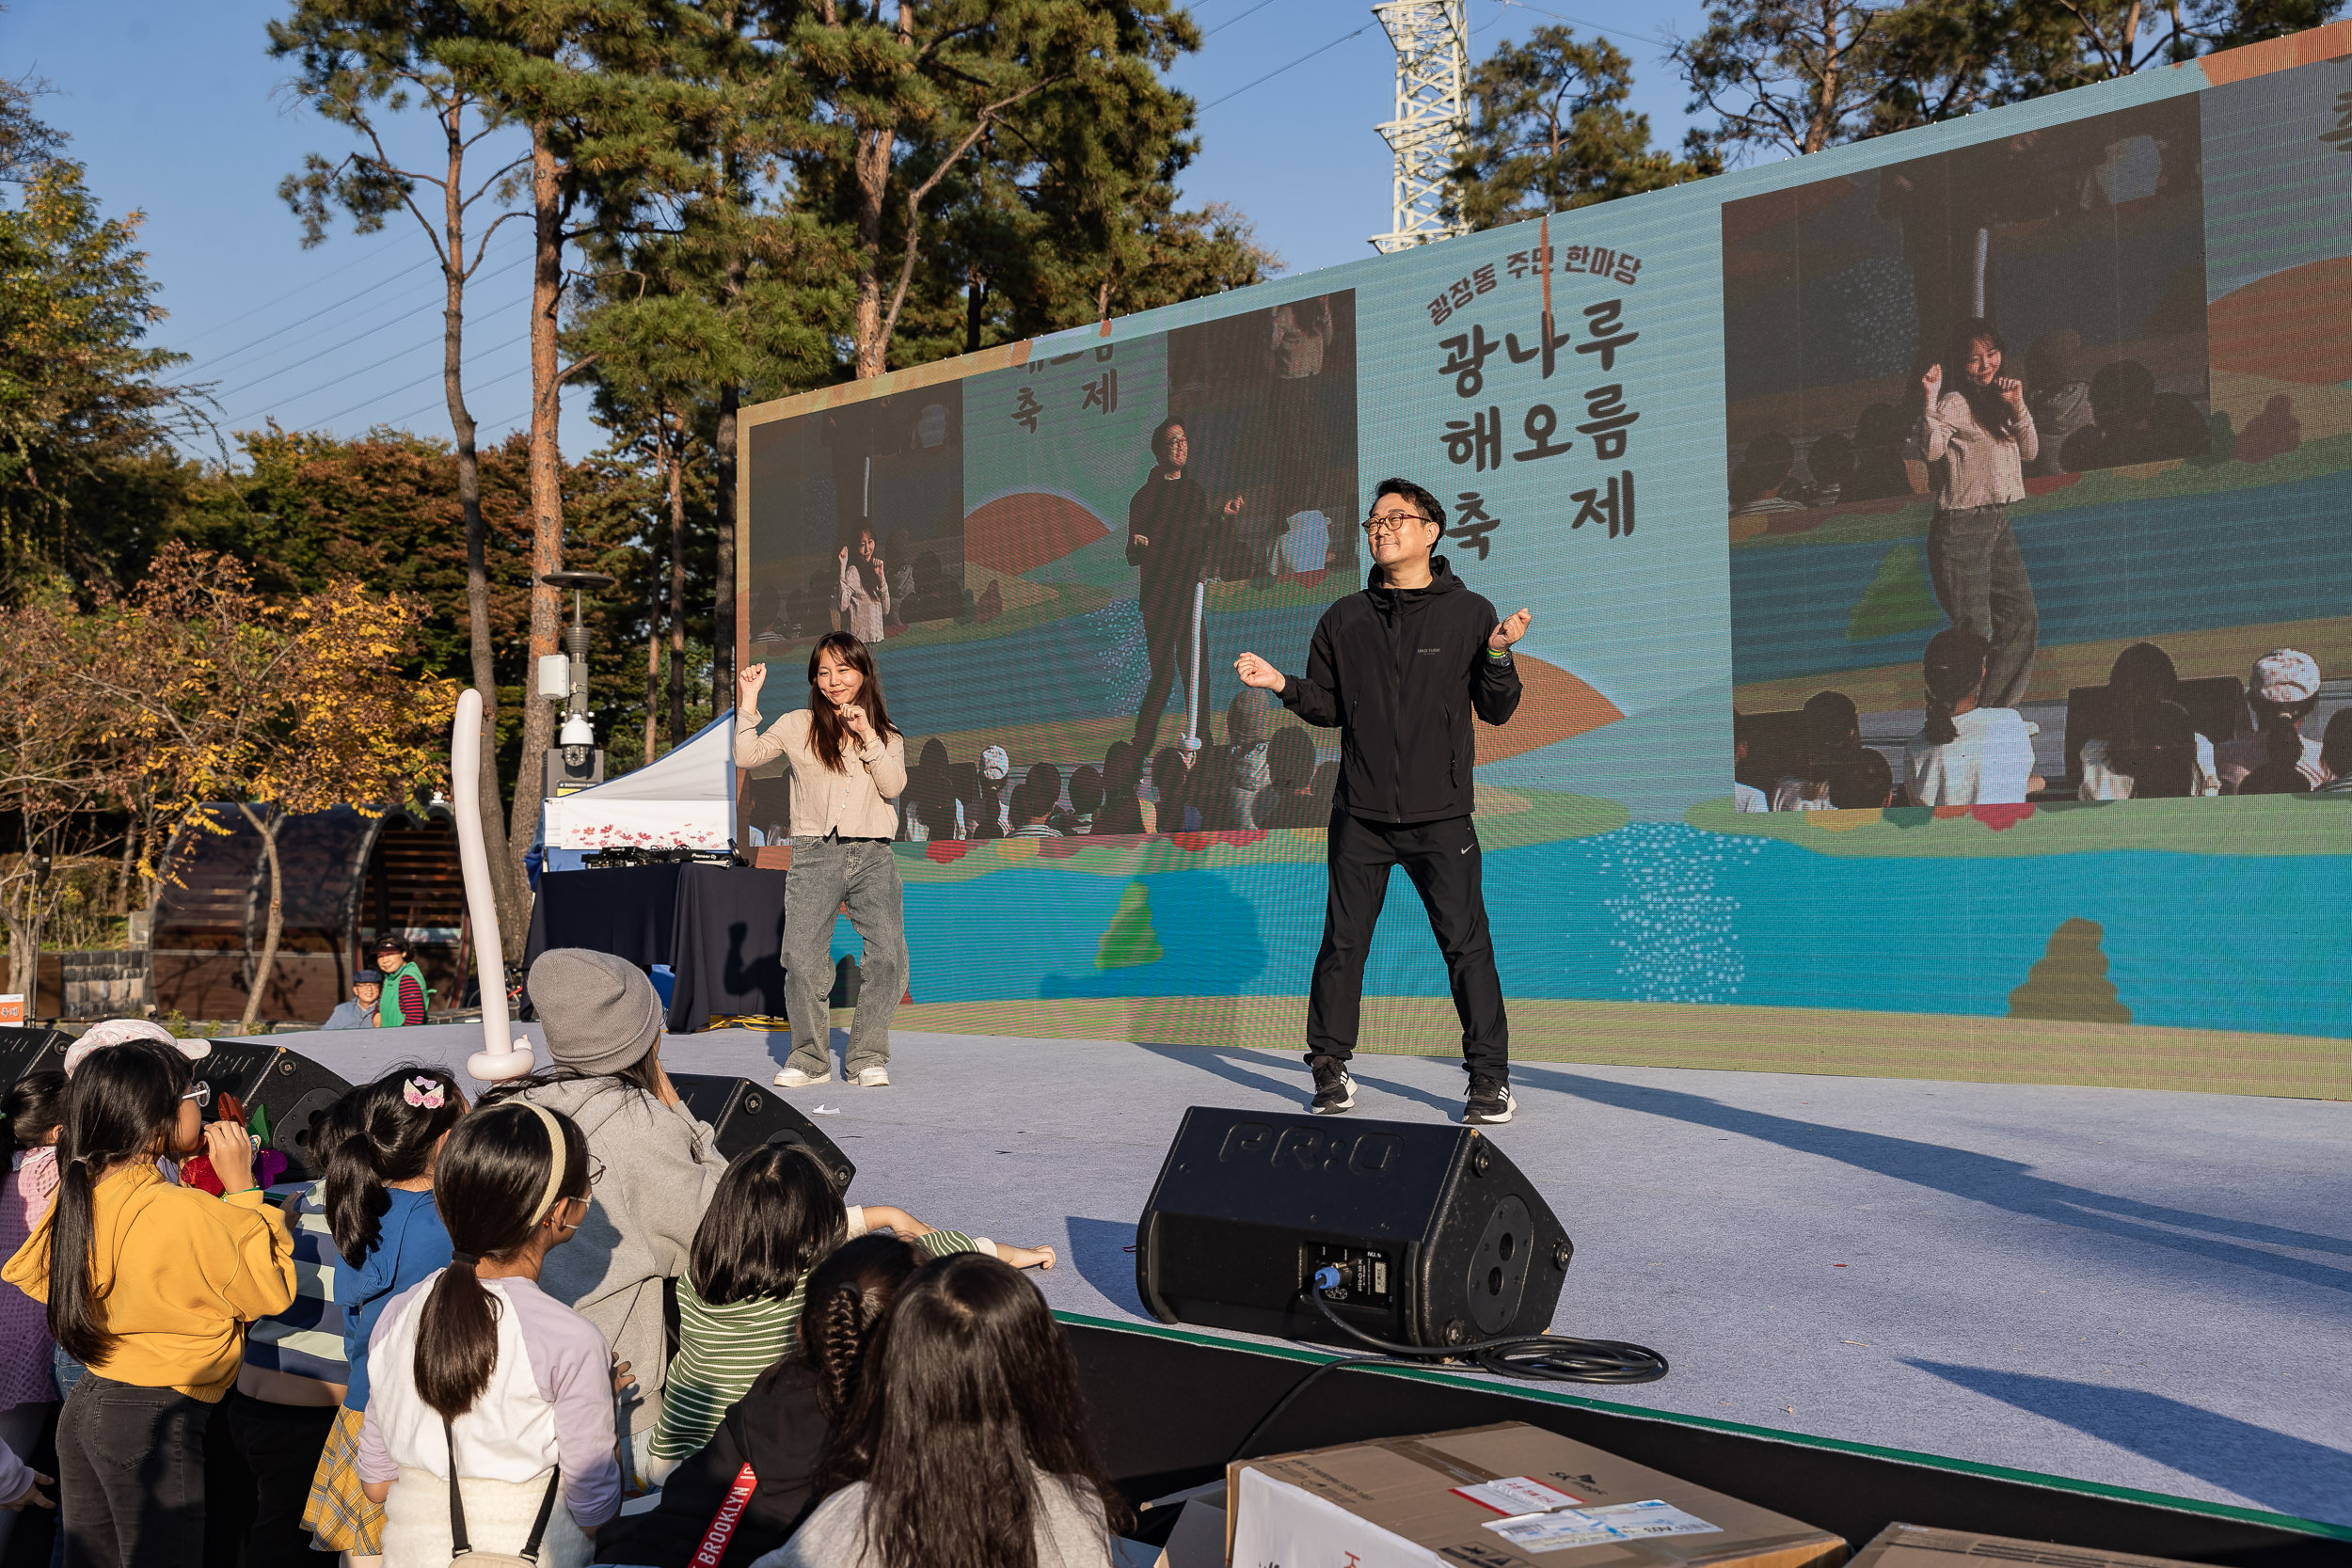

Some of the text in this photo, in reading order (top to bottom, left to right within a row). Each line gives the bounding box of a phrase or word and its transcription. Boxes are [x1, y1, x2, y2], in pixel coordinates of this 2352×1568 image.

[1426, 245, 1642, 326] 광장동 주민 한마당
[1438, 298, 1640, 399] 광나루
[1439, 383, 1640, 472] 해오름
[697, 1486, 750, 1565] BROOKLYN
